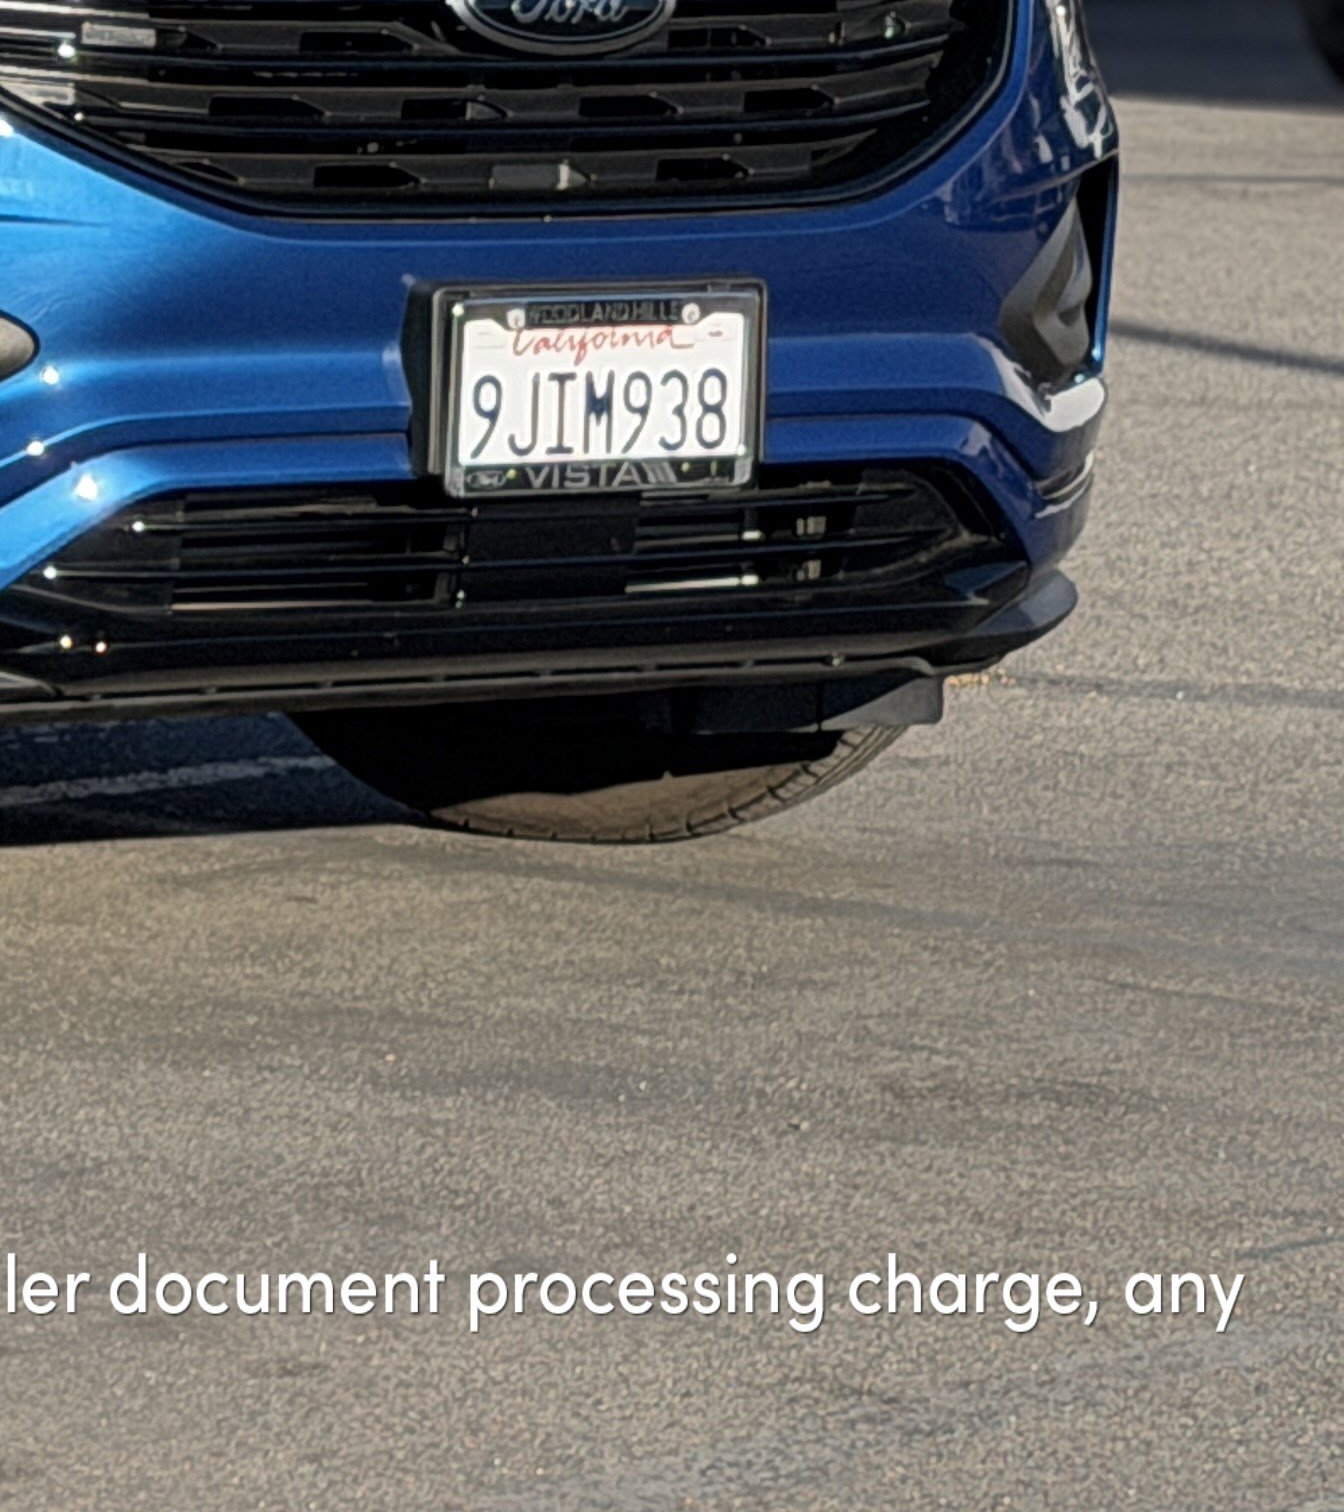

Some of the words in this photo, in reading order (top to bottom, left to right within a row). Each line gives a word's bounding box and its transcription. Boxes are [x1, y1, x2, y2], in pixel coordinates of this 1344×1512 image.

[512, 323, 695, 366] California
[469, 367, 728, 460] 9JIM938
[525, 461, 642, 489] VISTA
